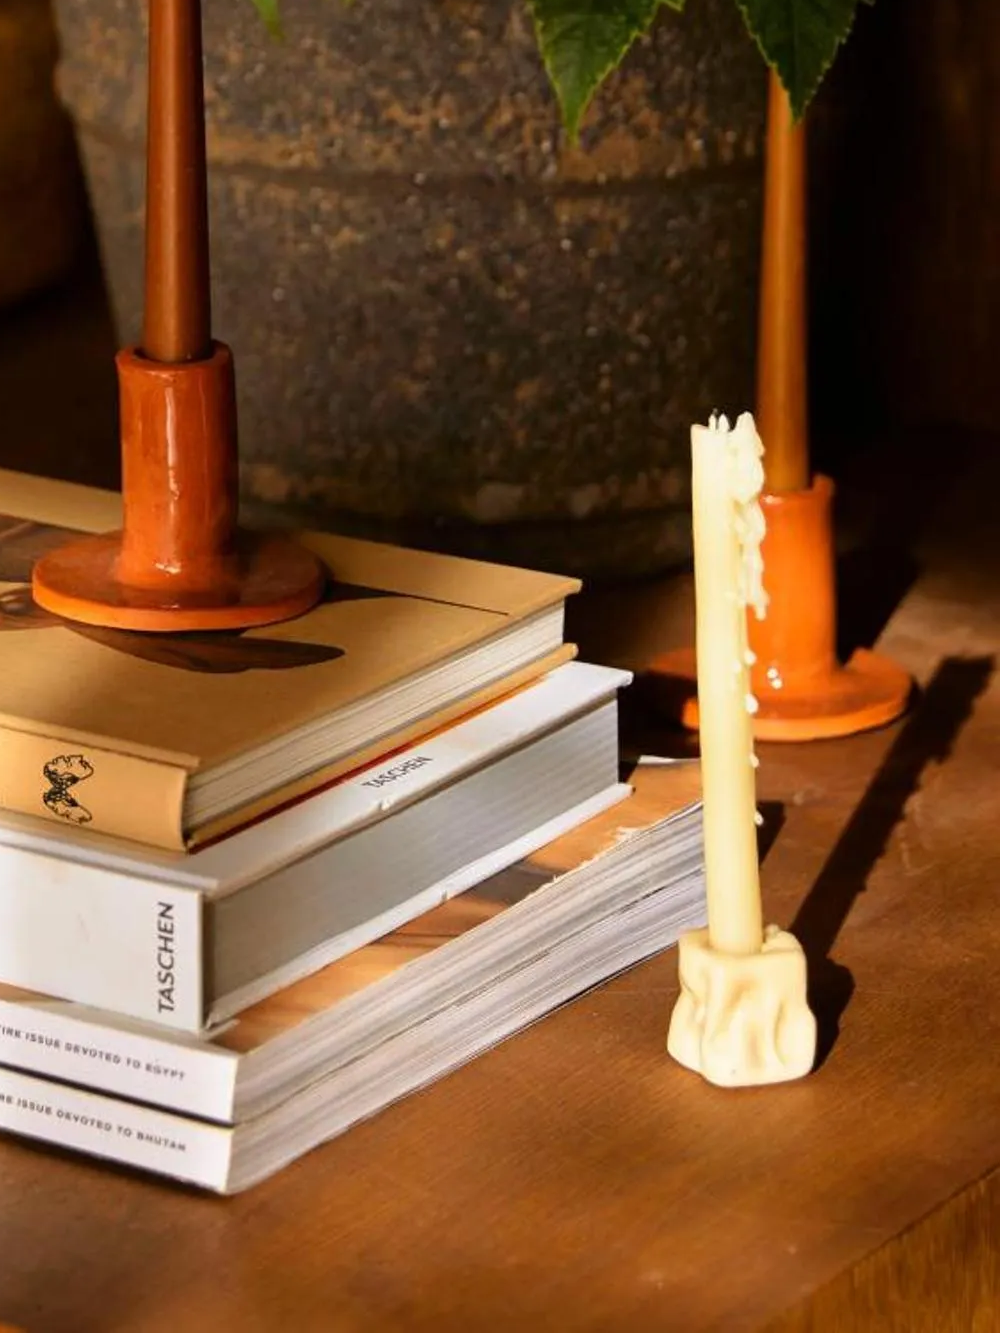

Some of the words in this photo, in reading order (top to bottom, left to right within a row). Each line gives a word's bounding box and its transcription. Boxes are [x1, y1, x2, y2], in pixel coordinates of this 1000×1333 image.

[361, 754, 434, 789] TASCHEN
[157, 900, 176, 1015] TASCHEN
[25, 1030, 62, 1049] ISSUE
[64, 1041, 122, 1065] DEVOTED
[125, 1056, 142, 1070] TO
[145, 1061, 187, 1082] EGYPT
[16, 1097, 53, 1116] ISSUE
[55, 1109, 114, 1133] DEVOTED
[116, 1125, 133, 1138] TO
[136, 1130, 188, 1153] BHUTAN
